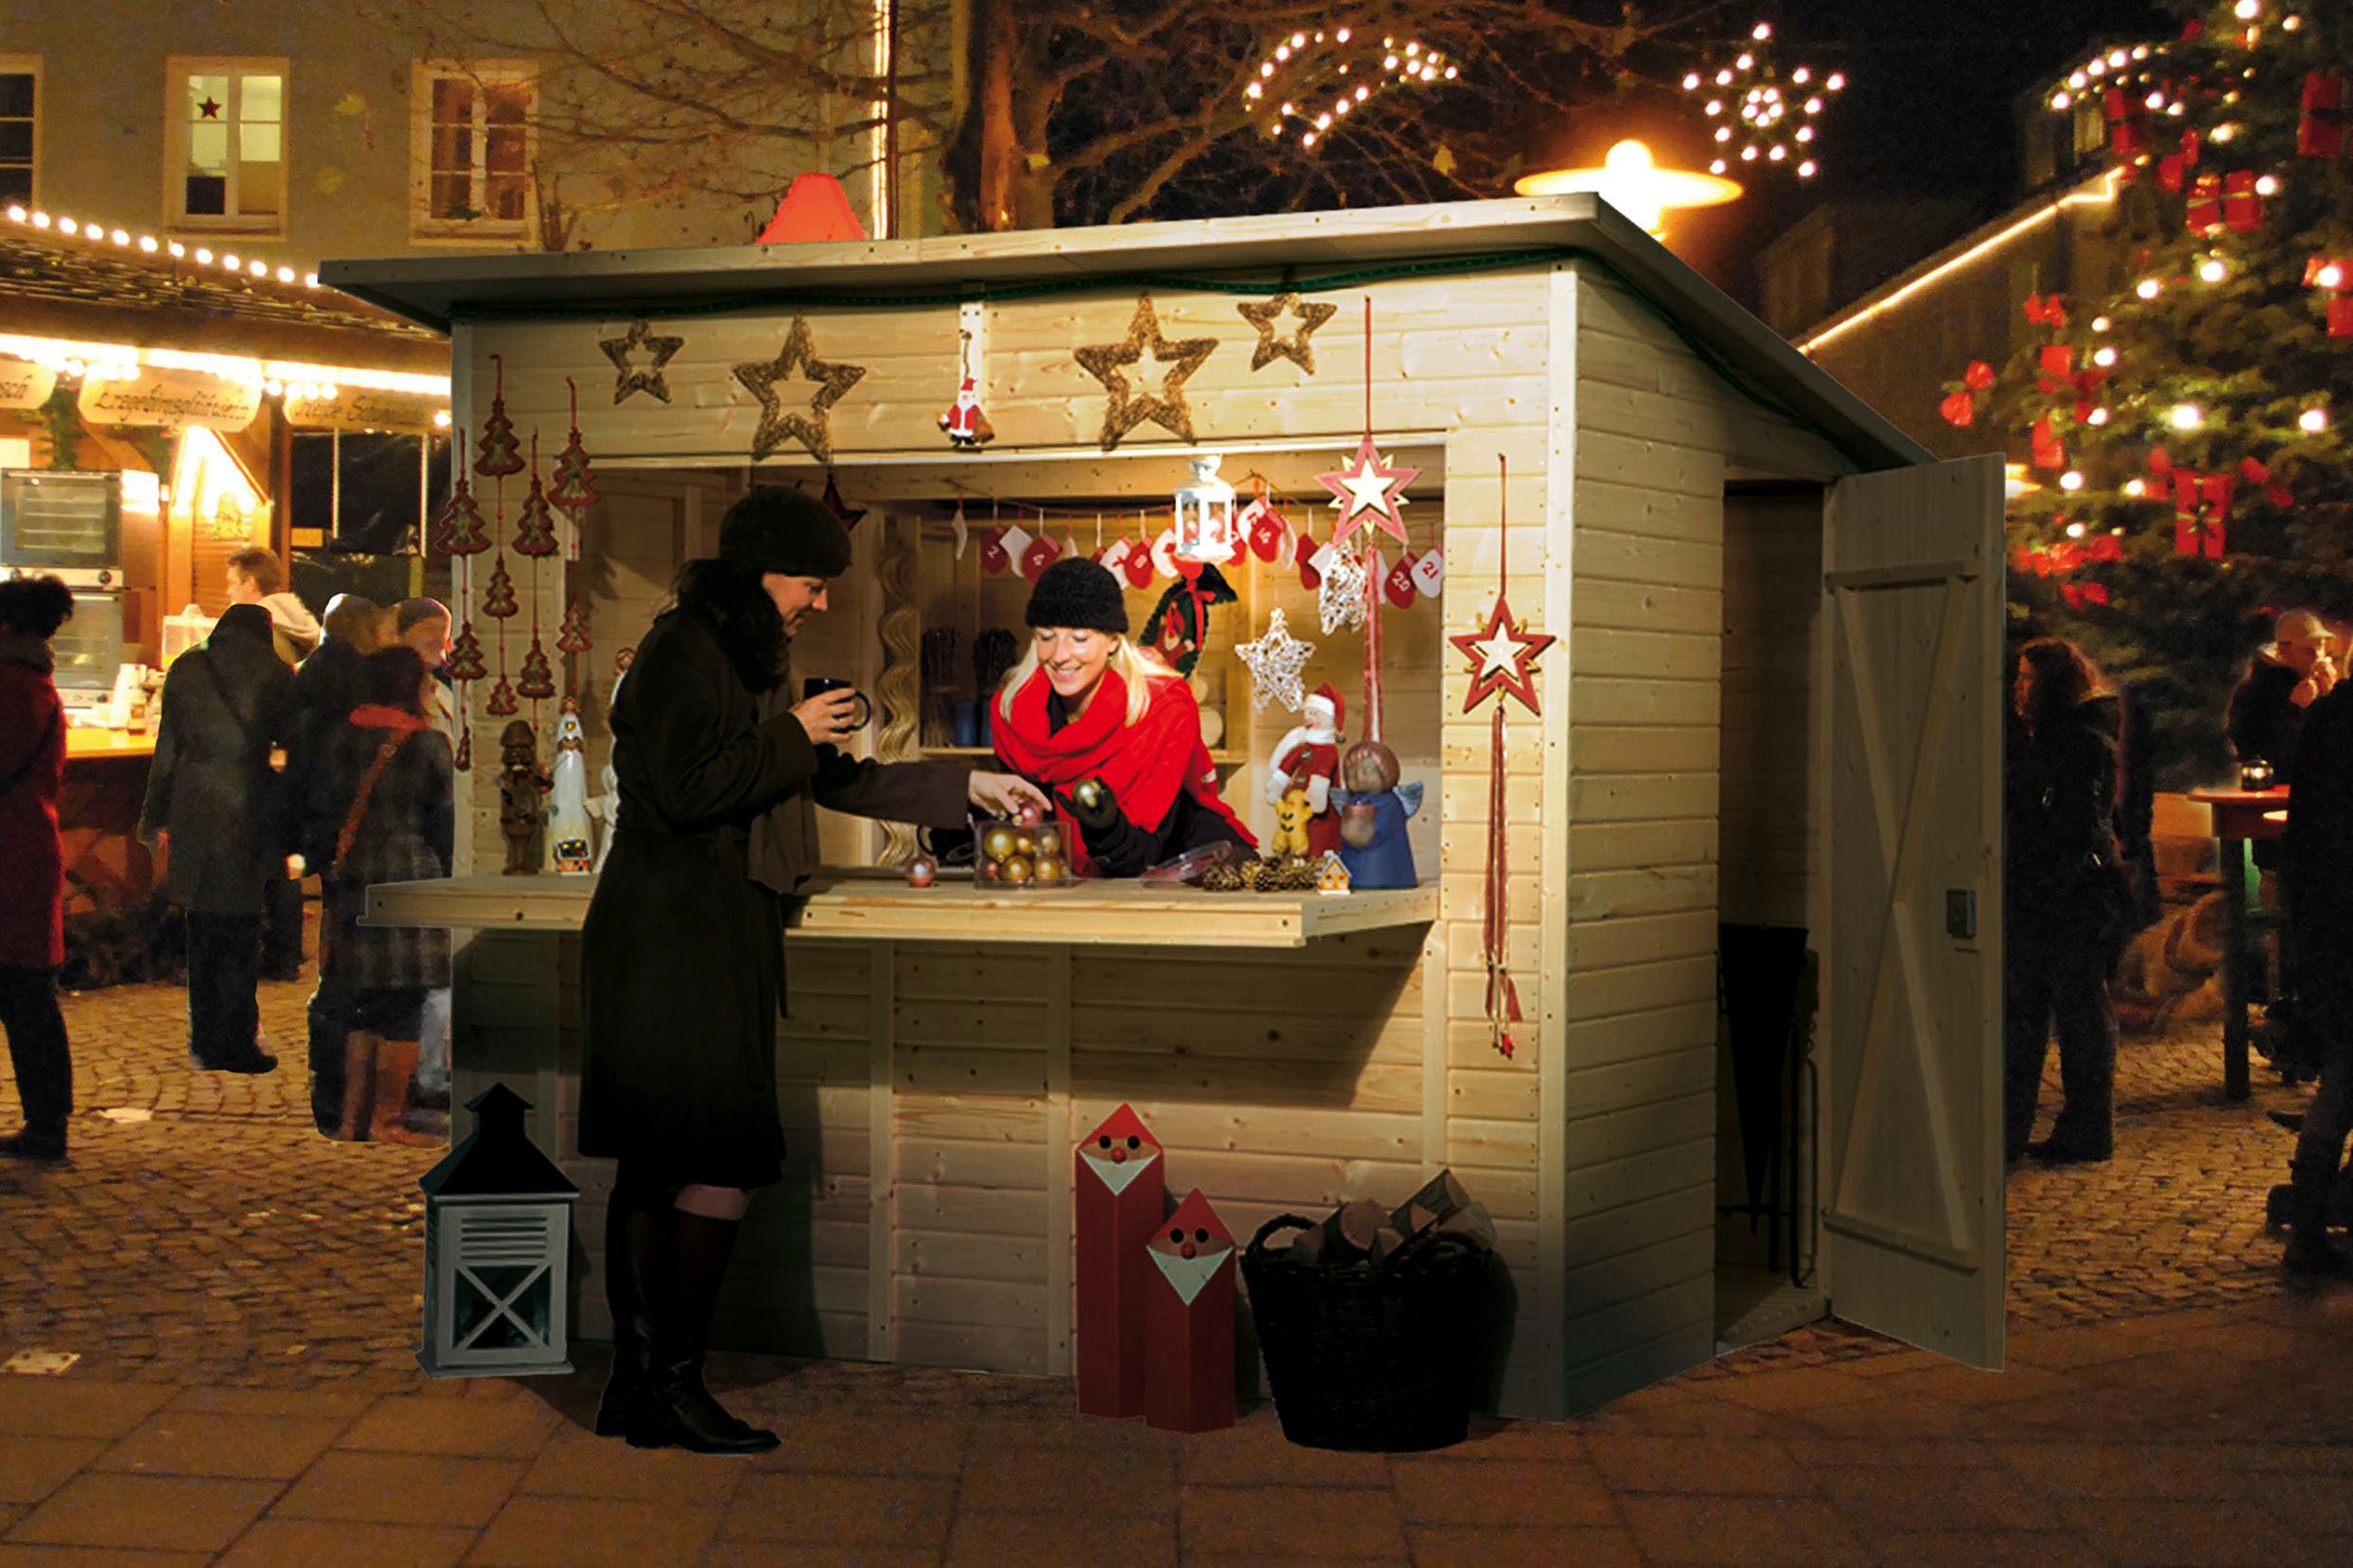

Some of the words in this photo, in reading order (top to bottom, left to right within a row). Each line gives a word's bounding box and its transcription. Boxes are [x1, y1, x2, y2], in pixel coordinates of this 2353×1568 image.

[988, 544, 999, 559] 2
[1423, 562, 1439, 580] 21
[1392, 571, 1411, 592] 20
